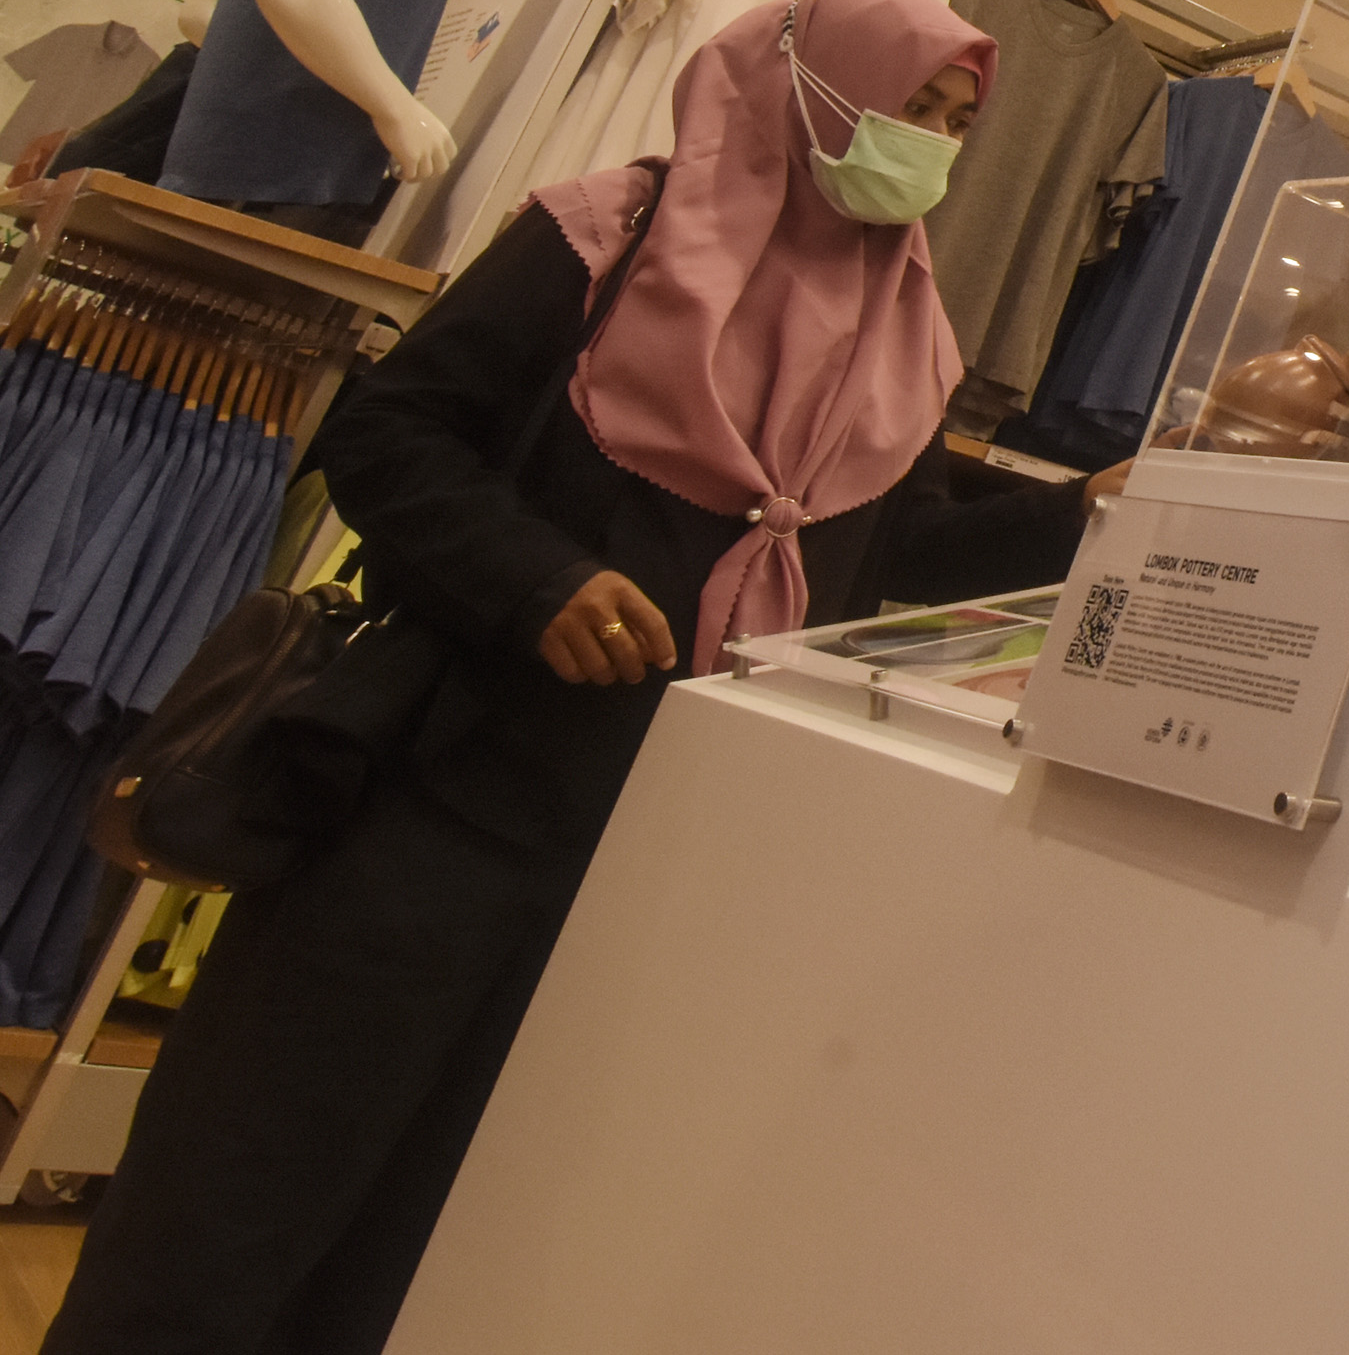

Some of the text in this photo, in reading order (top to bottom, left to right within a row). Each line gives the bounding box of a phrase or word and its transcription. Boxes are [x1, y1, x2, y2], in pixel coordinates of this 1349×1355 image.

[1145, 554, 1259, 584] LOMBOK POTTERY CENTRE
